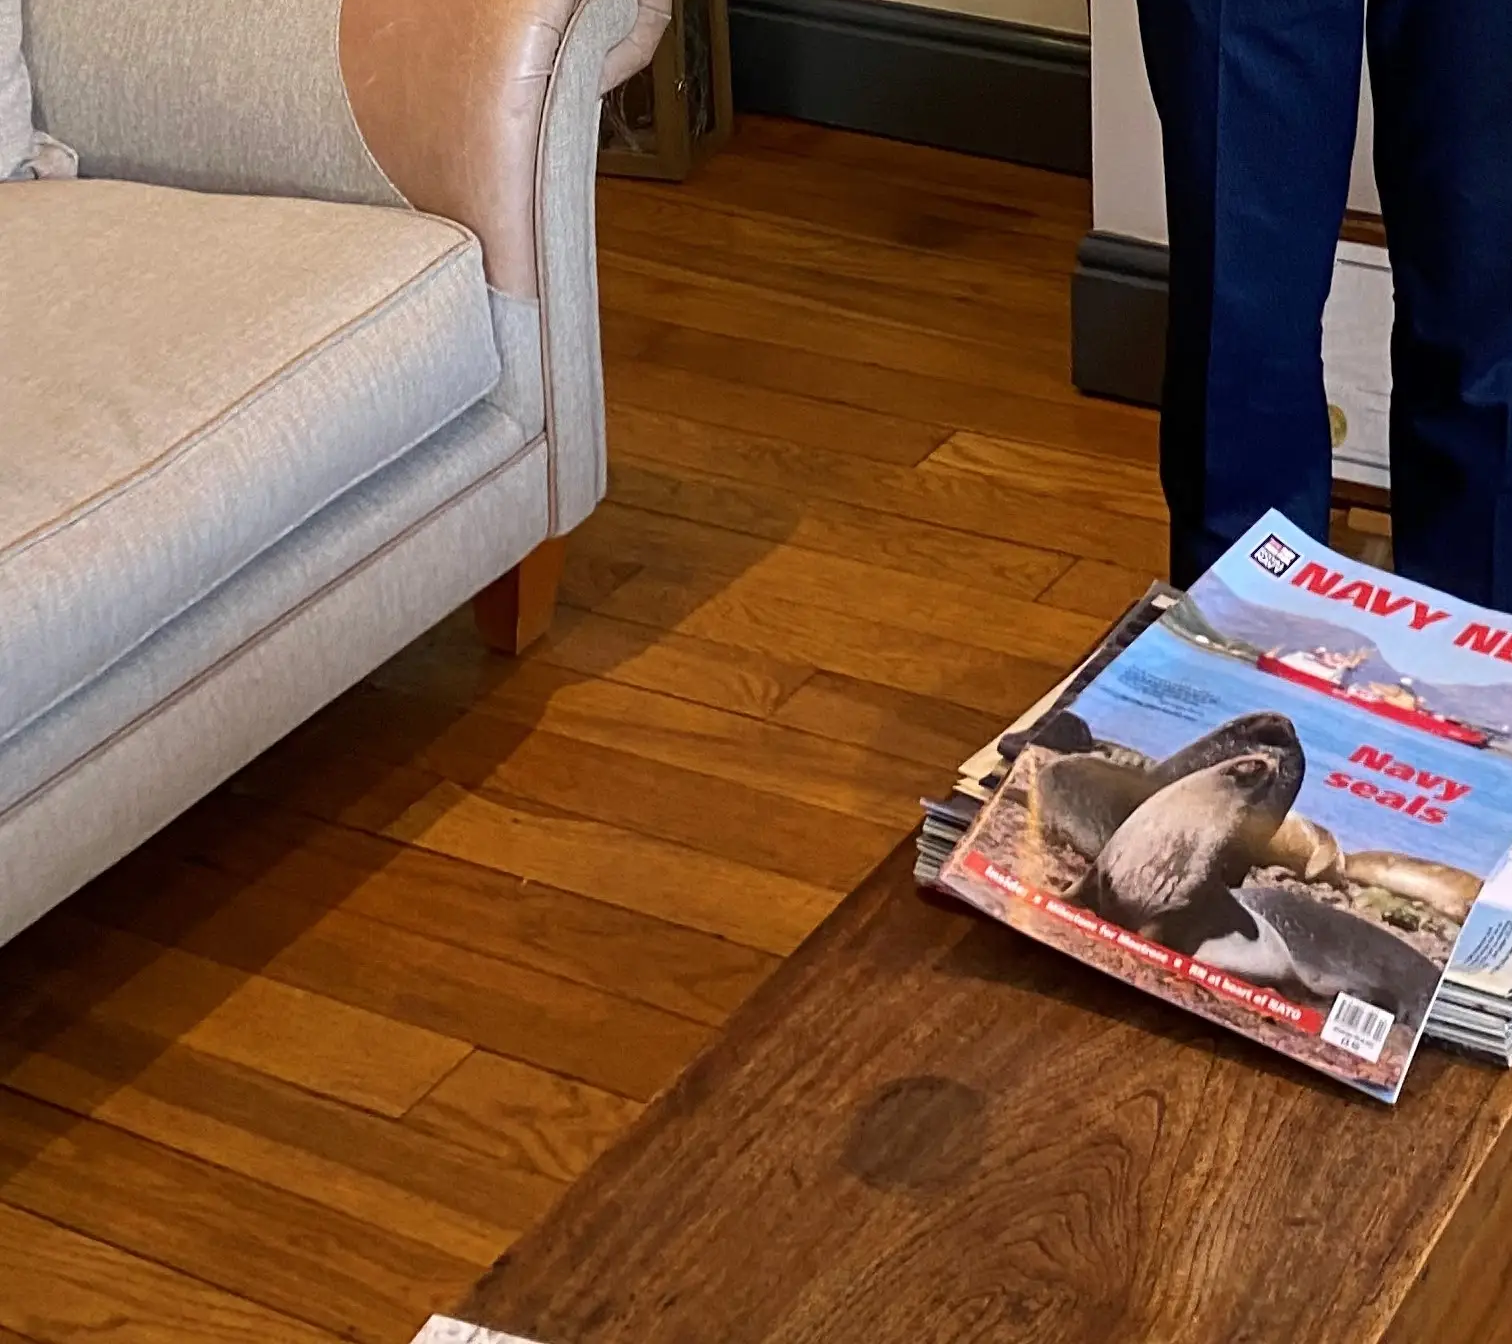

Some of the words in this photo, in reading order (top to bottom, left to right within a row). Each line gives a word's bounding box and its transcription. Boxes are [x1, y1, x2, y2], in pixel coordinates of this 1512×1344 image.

[1290, 561, 1453, 631] NAVY
[1322, 771, 1449, 825] seals
[1347, 743, 1474, 803] Navy
[1099, 923, 1118, 941] for
[1117, 932, 1169, 964] Montrose
[1207, 970, 1222, 987] at
[1222, 976, 1253, 1003] heart
[1253, 992, 1268, 1009] of
[1267, 997, 1303, 1022] NATO
